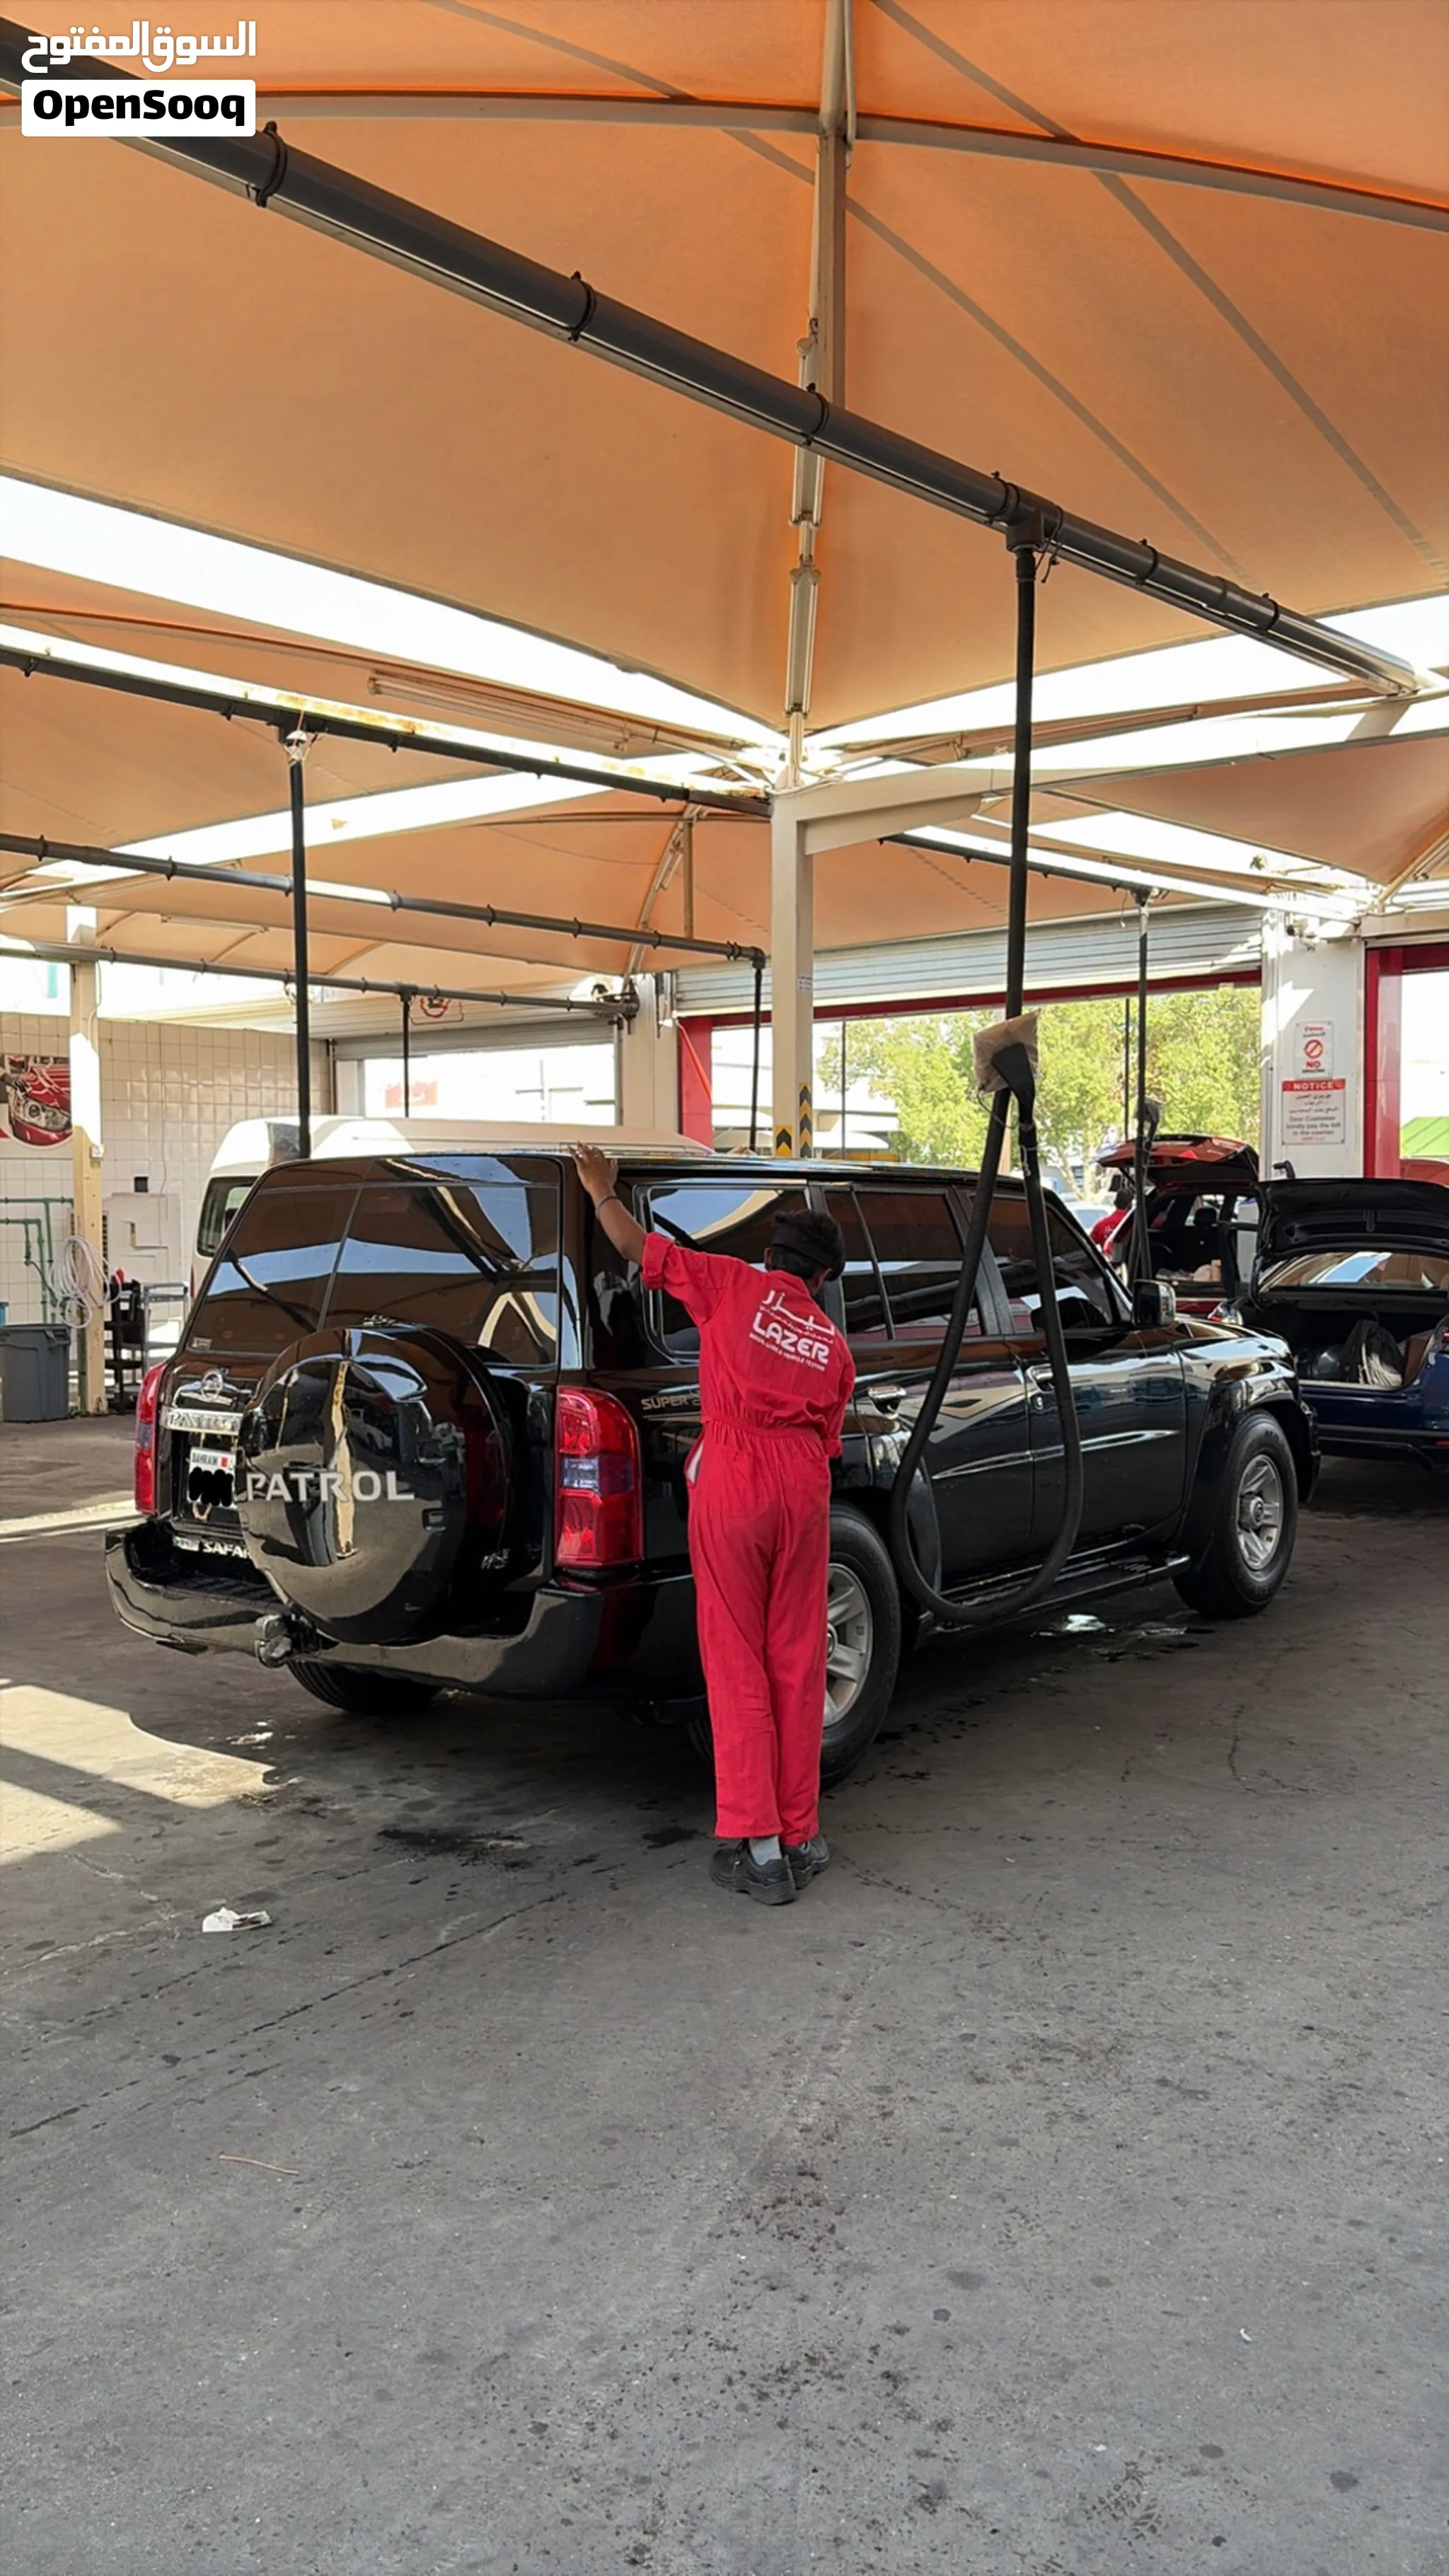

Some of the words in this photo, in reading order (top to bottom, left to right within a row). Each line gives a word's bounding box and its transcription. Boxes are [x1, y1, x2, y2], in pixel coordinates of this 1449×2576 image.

[1293, 1082, 1334, 1090] NOTICE
[752, 1311, 830, 1365] LAZER
[640, 1394, 688, 1410] SUPER
[247, 1471, 415, 1502] PATROL
